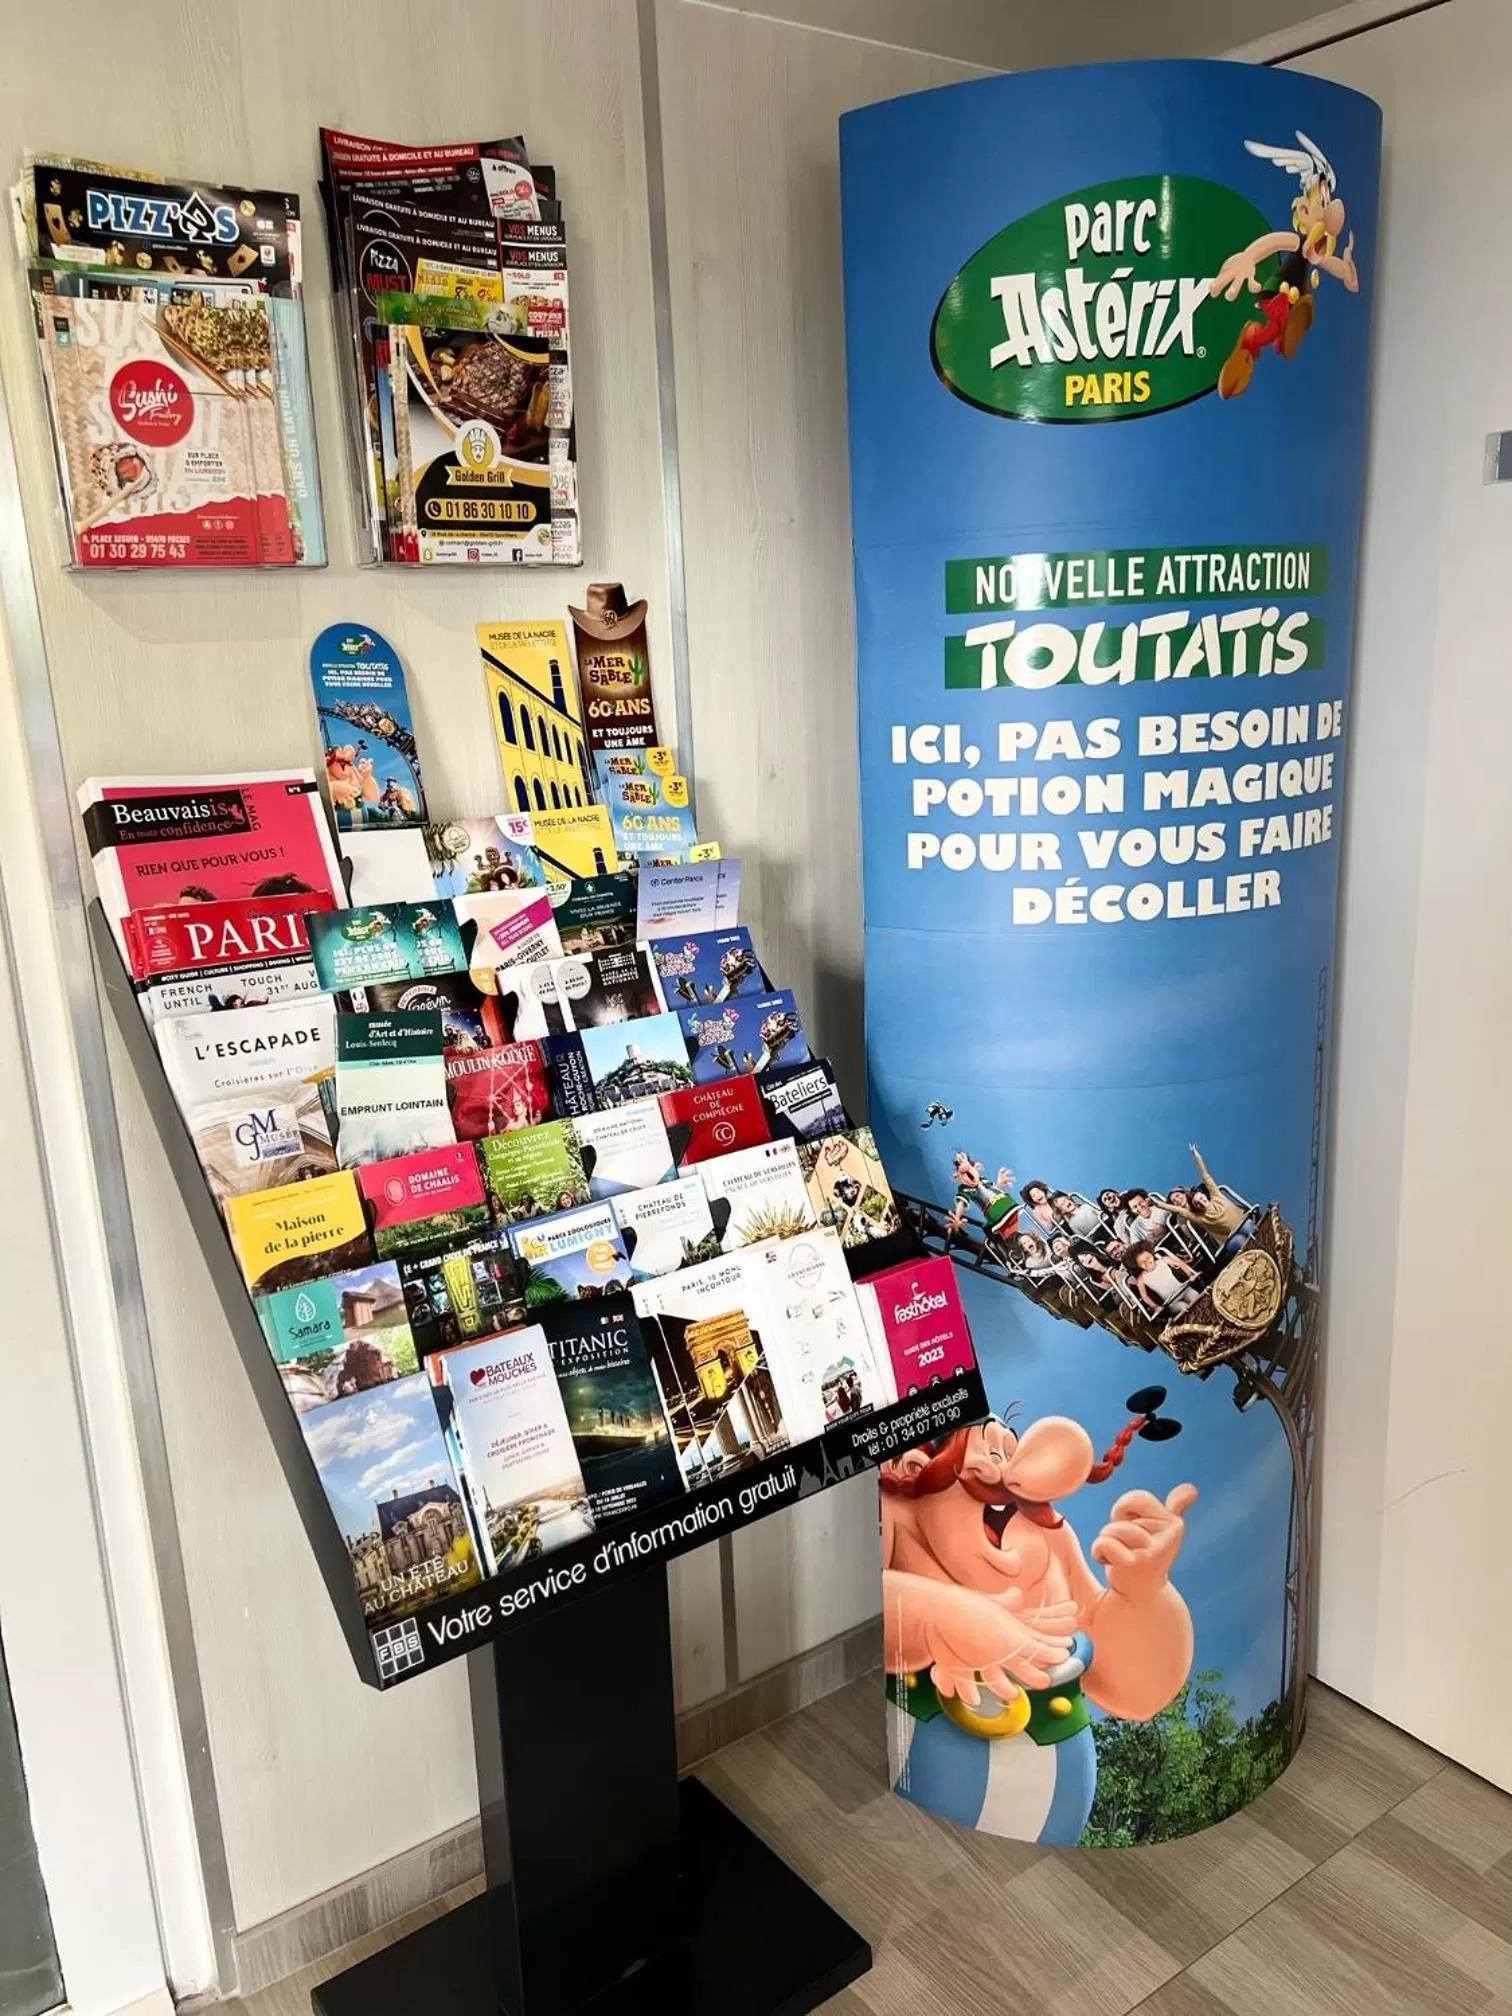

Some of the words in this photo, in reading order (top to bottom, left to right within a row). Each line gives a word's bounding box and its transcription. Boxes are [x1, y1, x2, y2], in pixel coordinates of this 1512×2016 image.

[423, 151, 432, 159] ET
[434, 150, 443, 158] AU
[444, 148, 474, 158] BUREAU
[353, 193, 384, 208] LIVRAISON
[385, 202, 411, 215] GRATUITE
[412, 207, 418, 216] À
[419, 210, 448, 222] DOMICILE
[449, 215, 456, 223] ET
[457, 216, 467, 225] AU
[468, 218, 495, 228] BUREAU
[356, 223, 387, 237] LIVRAISON
[388, 231, 414, 244] GRATUITE
[415, 236, 421, 245] À
[421, 238, 453, 249] DOMICILE
[454, 243, 461, 251] ET
[461, 244, 471, 253] AU
[472, 246, 497, 256] BUREAU
[508, 224, 526, 235] VOS
[527, 225, 558, 237] MENUS
[1064, 198, 1157, 260] parc
[510, 251, 527, 261] VOS
[528, 251, 559, 262] MENUS
[989, 267, 1217, 369] Astérix
[1065, 370, 1151, 407] PARIS
[118, 378, 178, 422] Sushi
[455, 469, 485, 482] Golden
[487, 471, 505, 483] Grill
[446, 501, 460, 517] 01
[463, 502, 478, 519] 86
[481, 502, 496, 519] 30
[500, 503, 512, 519] 10
[517, 503, 529, 519] 10
[91, 534, 112, 543] PLACE
[90, 543, 104, 558] 01
[109, 543, 126, 559] 30
[130, 543, 147, 559] 29
[151, 544, 166, 559] 75
[169, 544, 186, 559] 43
[975, 556, 1145, 606] NOVELLE
[1155, 551, 1311, 595] ATTRACTION
[593, 655, 626, 669] MER
[588, 698, 612, 718] 60
[615, 698, 652, 716] ANS
[592, 728, 604, 738] ET
[606, 724, 654, 738] TOUJOURS
[891, 723, 982, 769] ICI,
[999, 717, 1121, 763] PAS
[1138, 705, 1310, 756] BESOIN
[1317, 699, 1344, 739] DE
[604, 738, 624, 749] UNE
[610, 757, 633, 766] MER
[625, 782, 648, 792] MER
[912, 773, 1125, 817] POTION
[1142, 752, 1335, 811] MAGIQUE
[622, 791, 652, 804] SABLE
[111, 798, 229, 825] Beauvaisis
[557, 818, 567, 826] DE
[622, 813, 646, 831] 60
[647, 815, 681, 832] ANS
[119, 829, 136, 841] En
[159, 819, 232, 838] confidence
[907, 832, 1063, 871] POUR
[1076, 821, 1227, 869] VOUS
[1239, 803, 1333, 858] FAIRE
[136, 862, 168, 877] RIEN
[170, 859, 200, 874] QUE
[200, 853, 238, 870] POUR
[240, 847, 278, 863] VOUS
[1011, 869, 1281, 925] DÉCOLLER
[183, 912, 311, 960] PARI
[160, 983, 214, 999] FRENCH
[240, 974, 283, 988] TOUCH
[163, 996, 203, 1011] UNTIL
[194, 1027, 321, 1061] L'ESCAPADE
[368, 1029, 388, 1039] d'Art
[388, 1029, 397, 1037] et
[397, 1027, 435, 1037] d'Histoire
[443, 1055, 491, 1080] MOULIN
[490, 1044, 538, 1069] ROUGE
[268, 1070, 283, 1079] sur
[693, 1087, 734, 1104] CHÂTEAU
[769, 1076, 828, 1110] Bateliers
[340, 1102, 393, 1117] EMPRUNT
[395, 1098, 444, 1112] LOINTAIN
[709, 1100, 721, 1110] DE
[492, 1131, 549, 1152] Découvrez
[408, 1167, 449, 1185] DOMAINE
[410, 1184, 422, 1195] DE
[423, 1174, 462, 1191] CHAALIS
[673, 1192, 684, 1202] DE
[275, 1213, 326, 1232] Maison
[635, 1201, 687, 1222] PIERREFONDS
[264, 1241, 283, 1255] de
[284, 1237, 299, 1250] la
[301, 1225, 345, 1248] pierre
[547, 1231, 567, 1242] PARCS
[567, 1217, 611, 1236] ZOOLOGIQUES
[550, 1224, 613, 1253] LUMIGNY
[419, 1255, 442, 1270] GRAND
[893, 1290, 948, 1325] fasthôtel
[288, 1320, 331, 1341] Samara
[547, 1328, 629, 1360] TITANIC
[485, 1351, 536, 1378] BATEAUX
[918, 1346, 945, 1368] 2023
[488, 1362, 538, 1387] MOUCHES
[851, 1427, 880, 1448] Droits
[879, 1421, 889, 1436] &
[890, 1403, 931, 1432] propriété
[931, 1387, 970, 1411] exclusifs
[885, 1435, 899, 1448] 01
[900, 1428, 915, 1442] 34
[916, 1419, 930, 1435] 07
[930, 1414, 946, 1427] 70
[945, 1406, 961, 1423] 90
[426, 1603, 494, 1647] Votre
[498, 1562, 588, 1618] service
[593, 1501, 736, 1574] d'information
[739, 1468, 799, 1517] gratuit
[380, 1573, 406, 1592] UN
[407, 1554, 446, 1580] ÉTÉ
[364, 1597, 387, 1615] AU
[389, 1558, 470, 1602] CHÂTEAU
